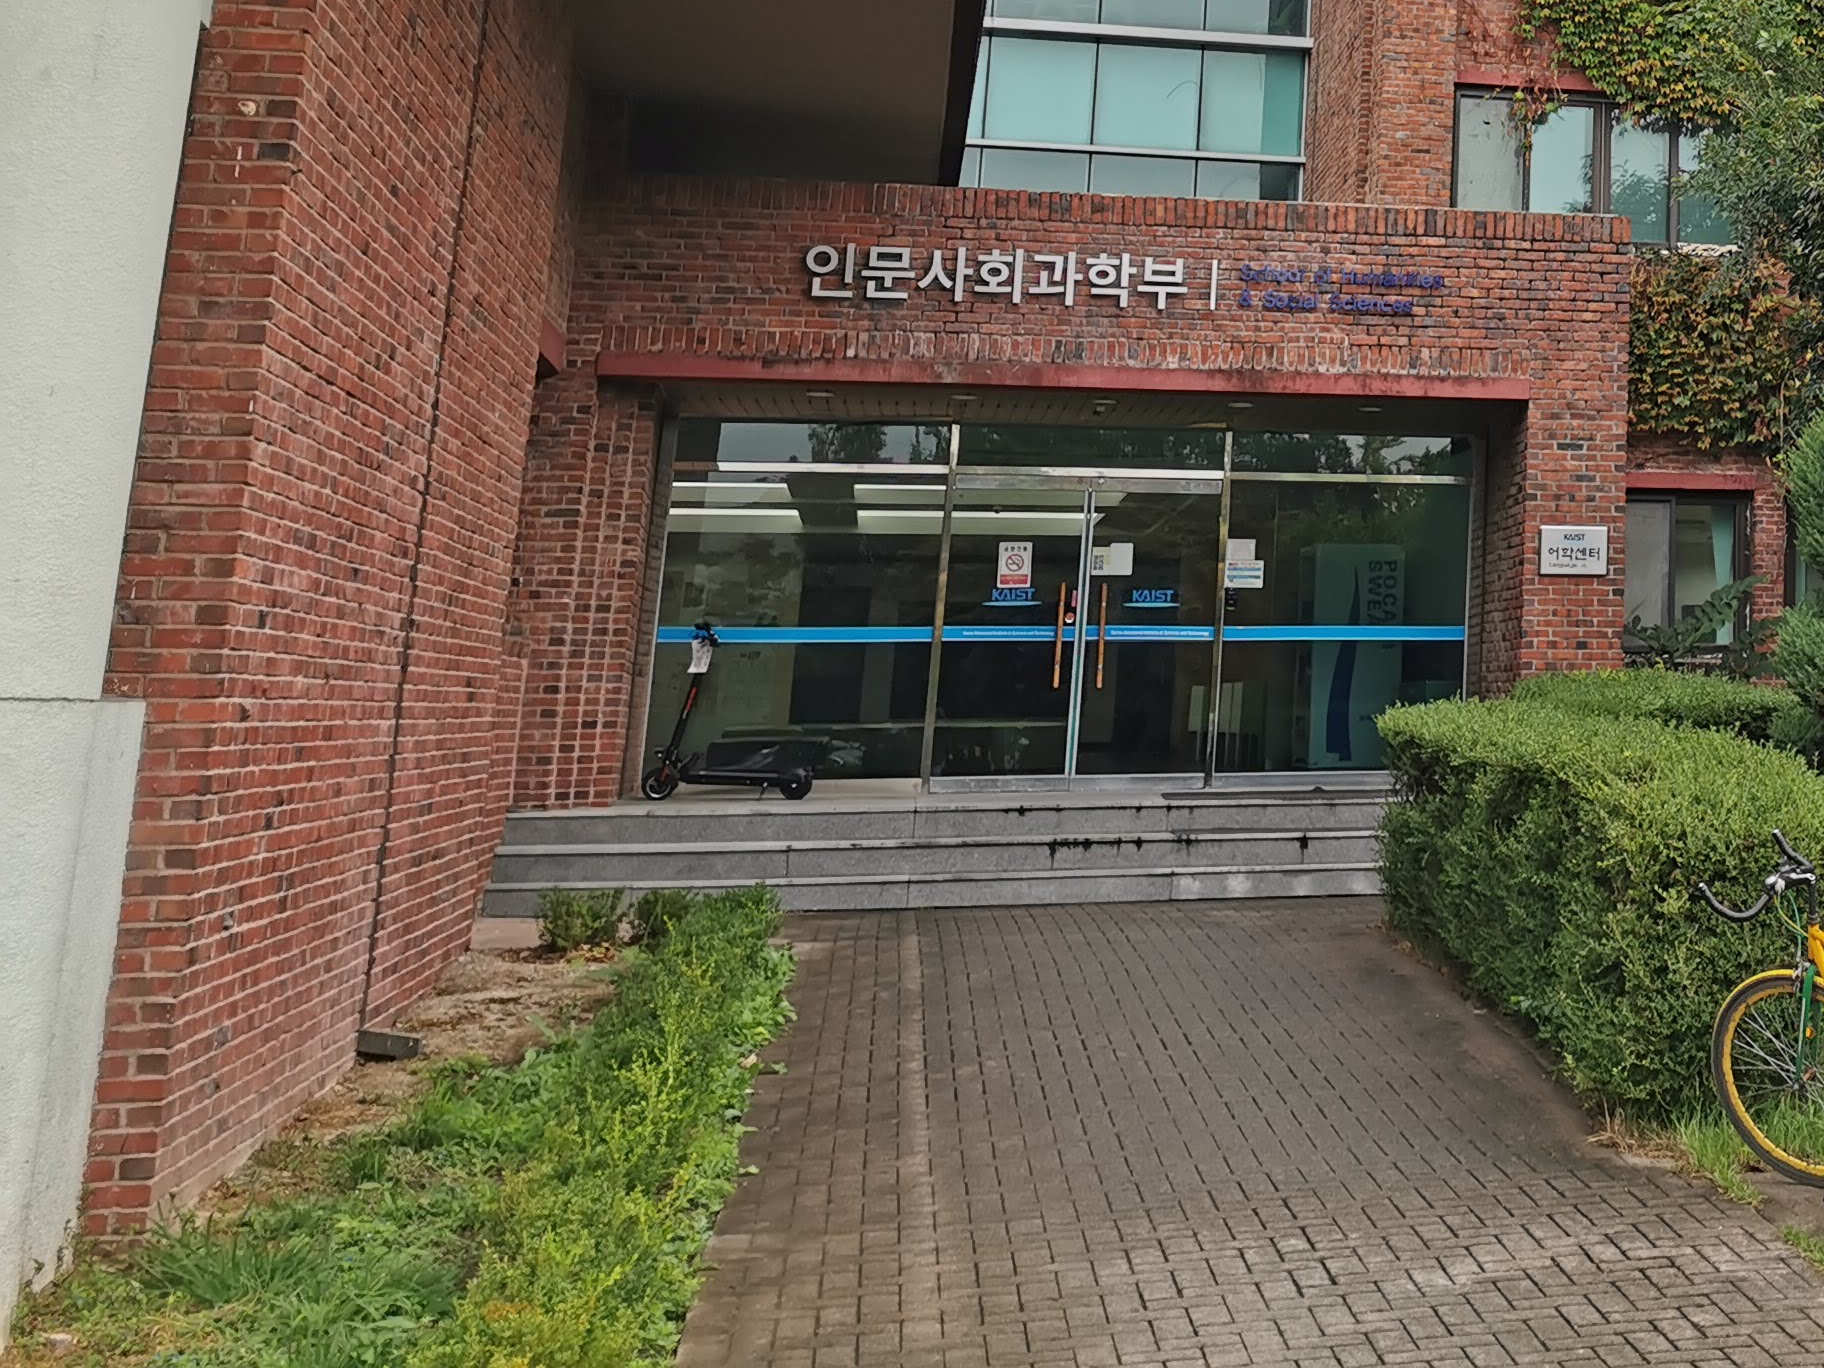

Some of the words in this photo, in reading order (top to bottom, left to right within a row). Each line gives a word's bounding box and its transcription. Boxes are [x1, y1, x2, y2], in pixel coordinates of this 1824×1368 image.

[805, 242, 1189, 311] 인문사회과학부
[1240, 264, 1305, 283] School
[1313, 266, 1334, 286] of
[1341, 268, 1446, 290] Humanities
[1238, 288, 1253, 307] &
[1262, 289, 1320, 311] Social
[1329, 292, 1415, 314] Sciences
[1563, 533, 1586, 541] KAIST
[1548, 546, 1601, 561] 어학센터
[991, 588, 1036, 601] KAIST
[1131, 589, 1175, 602] KAIST
